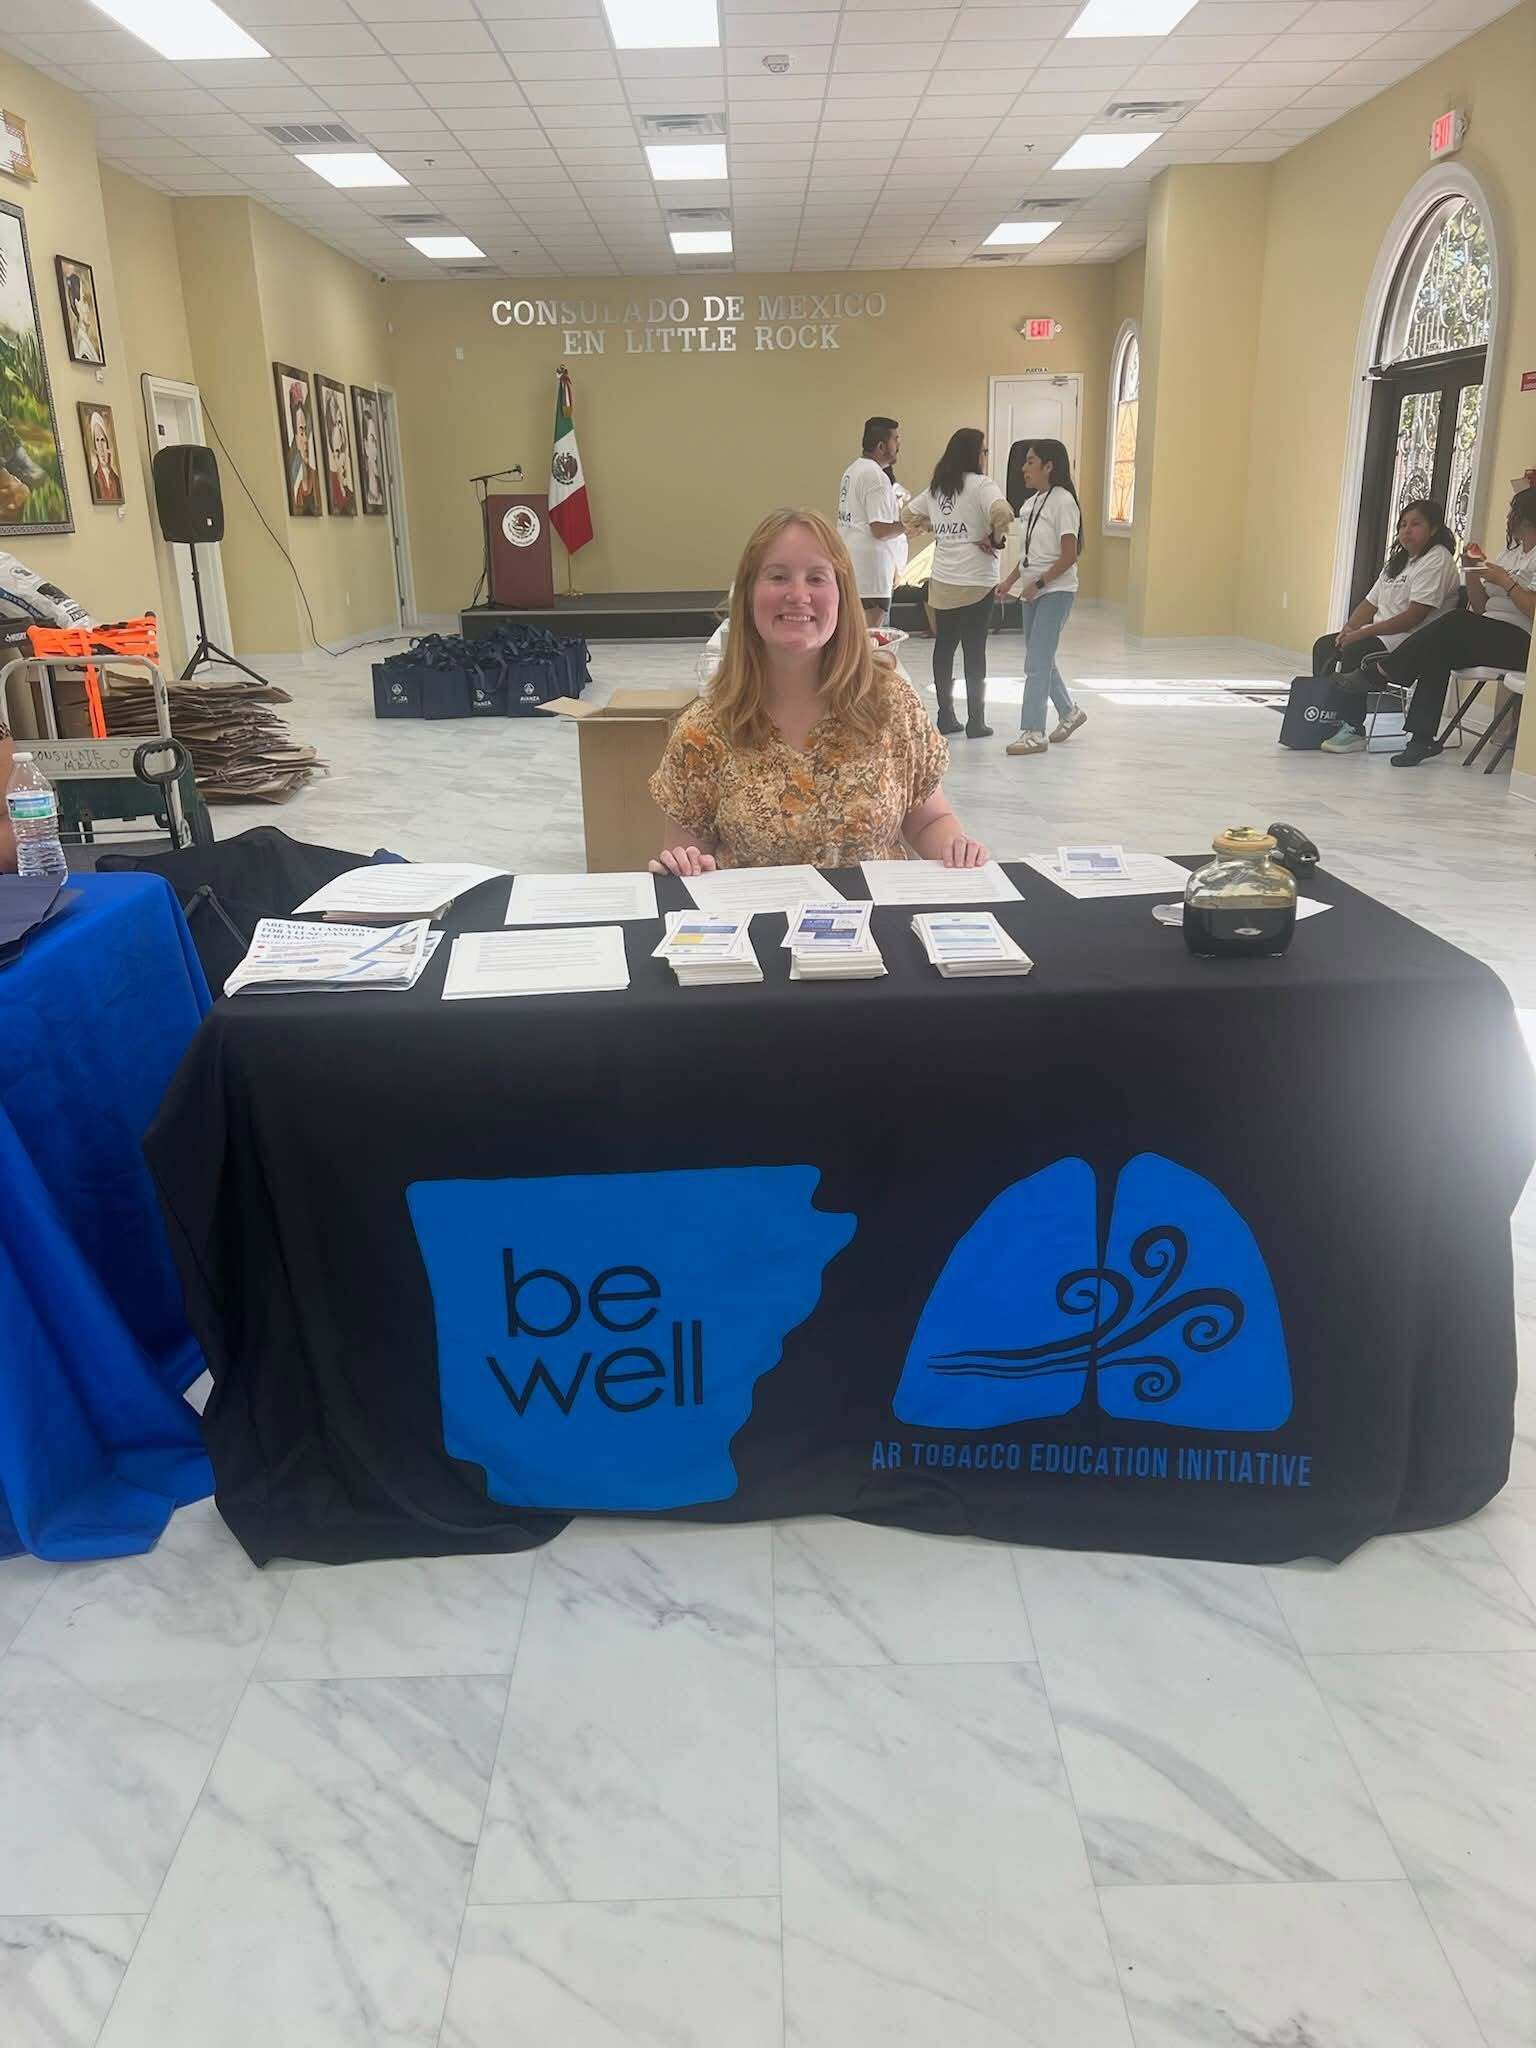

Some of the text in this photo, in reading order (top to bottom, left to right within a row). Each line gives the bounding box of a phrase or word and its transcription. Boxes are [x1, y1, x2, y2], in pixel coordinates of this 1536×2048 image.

[491, 292, 887, 326] CONSULADO DE MEXICO
[562, 324, 841, 356] EN LITTLE ROCK
[1031, 320, 1049, 337] EXIT
[933, 522, 968, 535] VANZA
[502, 1247, 662, 1338] be
[486, 1320, 703, 1417] well
[871, 1440, 1313, 1488] AR TOBACCO EDUCATION INITIATIVE
